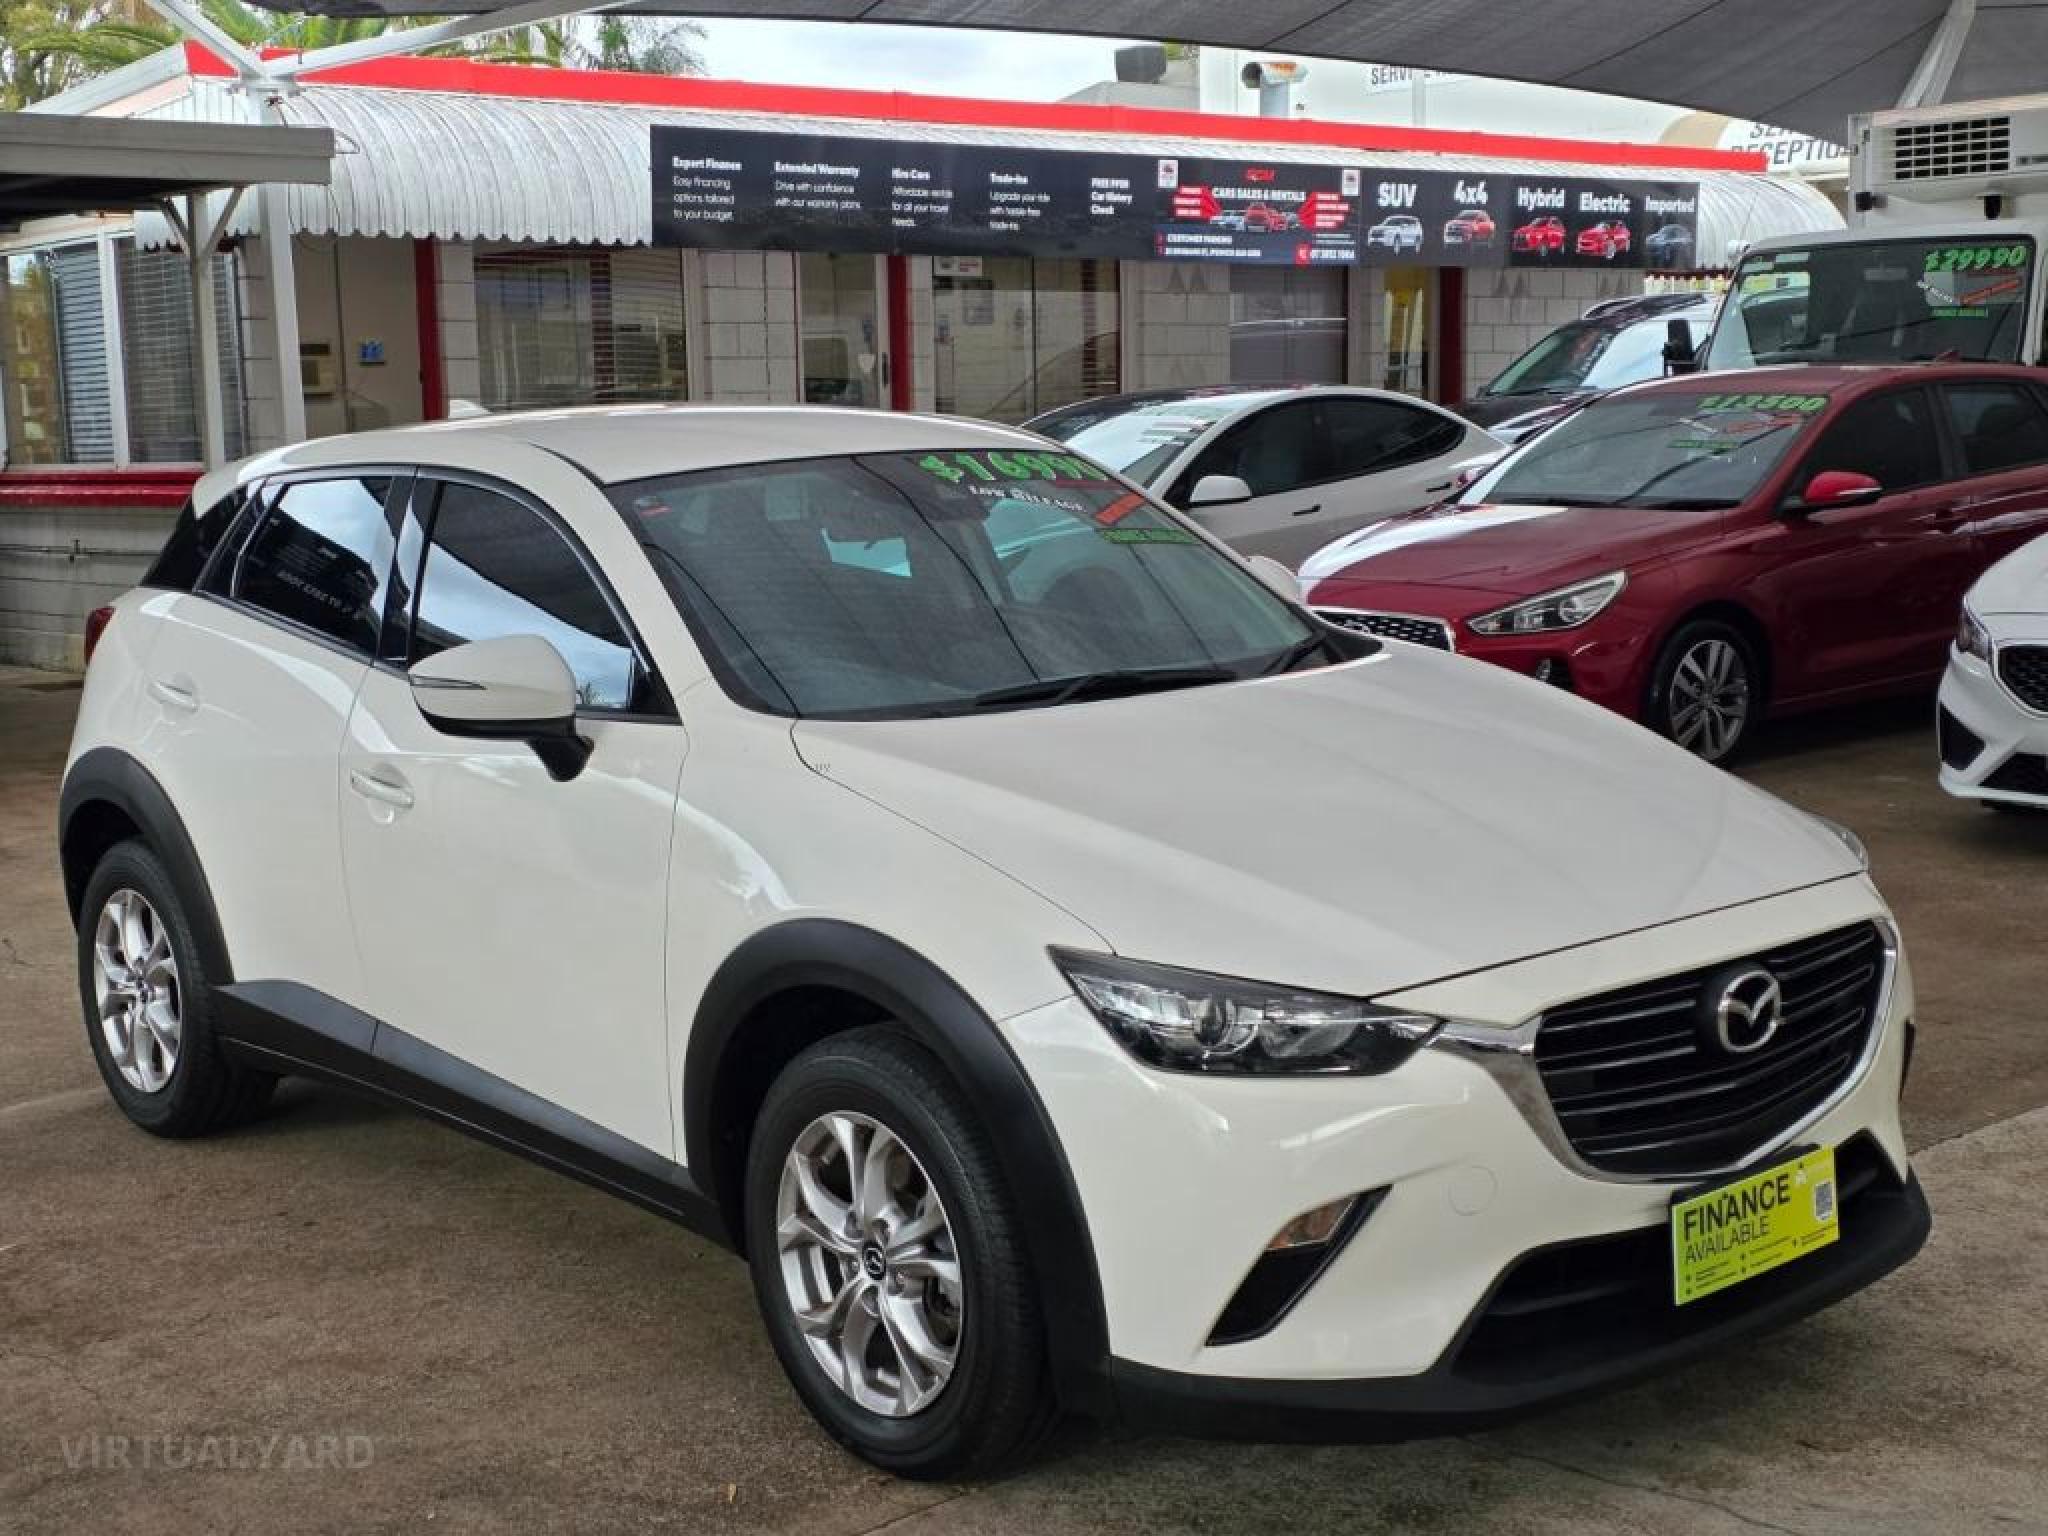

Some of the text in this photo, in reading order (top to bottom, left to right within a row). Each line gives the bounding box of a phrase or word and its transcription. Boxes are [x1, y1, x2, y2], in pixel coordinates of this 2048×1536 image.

[672, 156, 743, 171] Expert Finance
[775, 161, 860, 178] Extended Warranty
[672, 176, 731, 191] Easy financing
[775, 180, 855, 194] Drive with confidence
[1453, 180, 1488, 204] 4x4
[673, 193, 734, 205] options tailored
[1377, 183, 1417, 207] SUV
[1517, 187, 1565, 211] Hybrid
[1579, 192, 1631, 214] Electric
[792, 199, 805, 208] our
[807, 199, 839, 210] warranty
[1645, 197, 1695, 214] Imported
[684, 210, 702, 221] your
[1924, 245, 2027, 272] $29990
[1683, 1173, 1791, 1241] FINANCE
[1686, 1215, 1769, 1263] AVAILABLE
